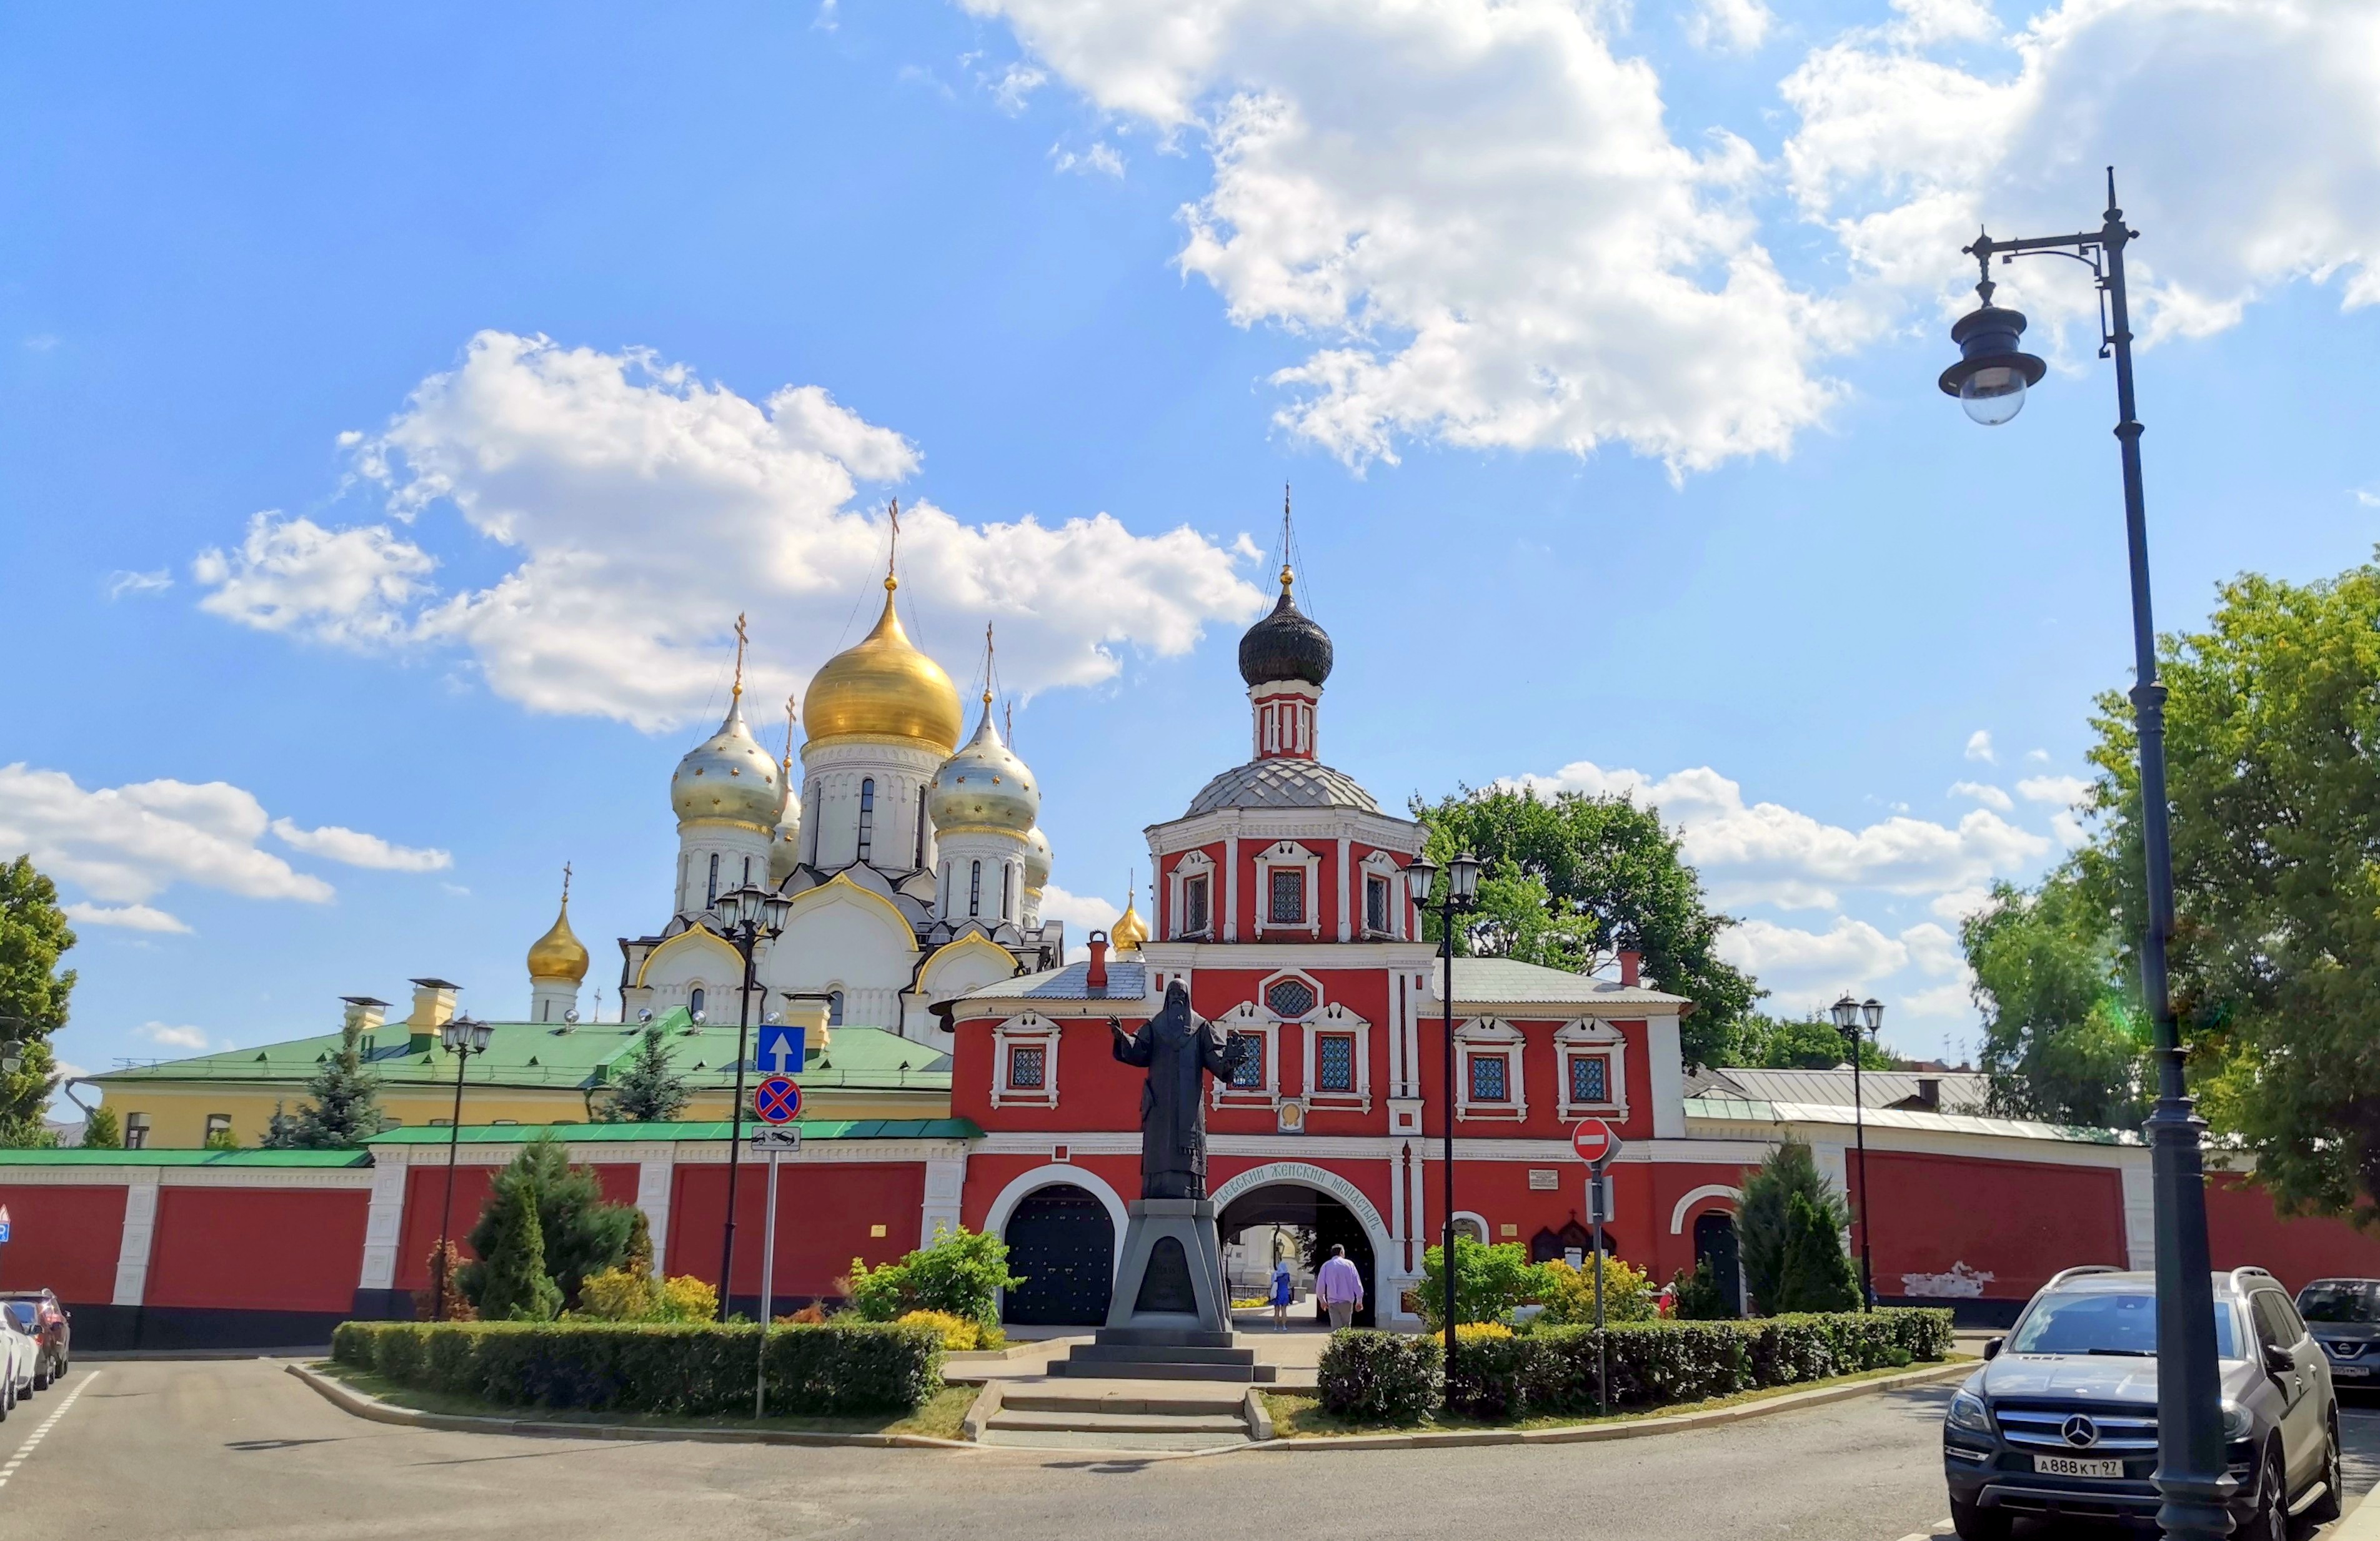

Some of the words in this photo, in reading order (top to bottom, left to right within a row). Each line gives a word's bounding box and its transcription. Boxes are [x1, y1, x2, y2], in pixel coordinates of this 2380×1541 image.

[1212, 1167, 1265, 1206] ТЬЕВСКИЙ
[1270, 1164, 1327, 1182] ЖЕНСКИЙ
[1331, 1177, 1380, 1231] МОНАСТЫРЬ
[2102, 1461, 2116, 1473] 97
